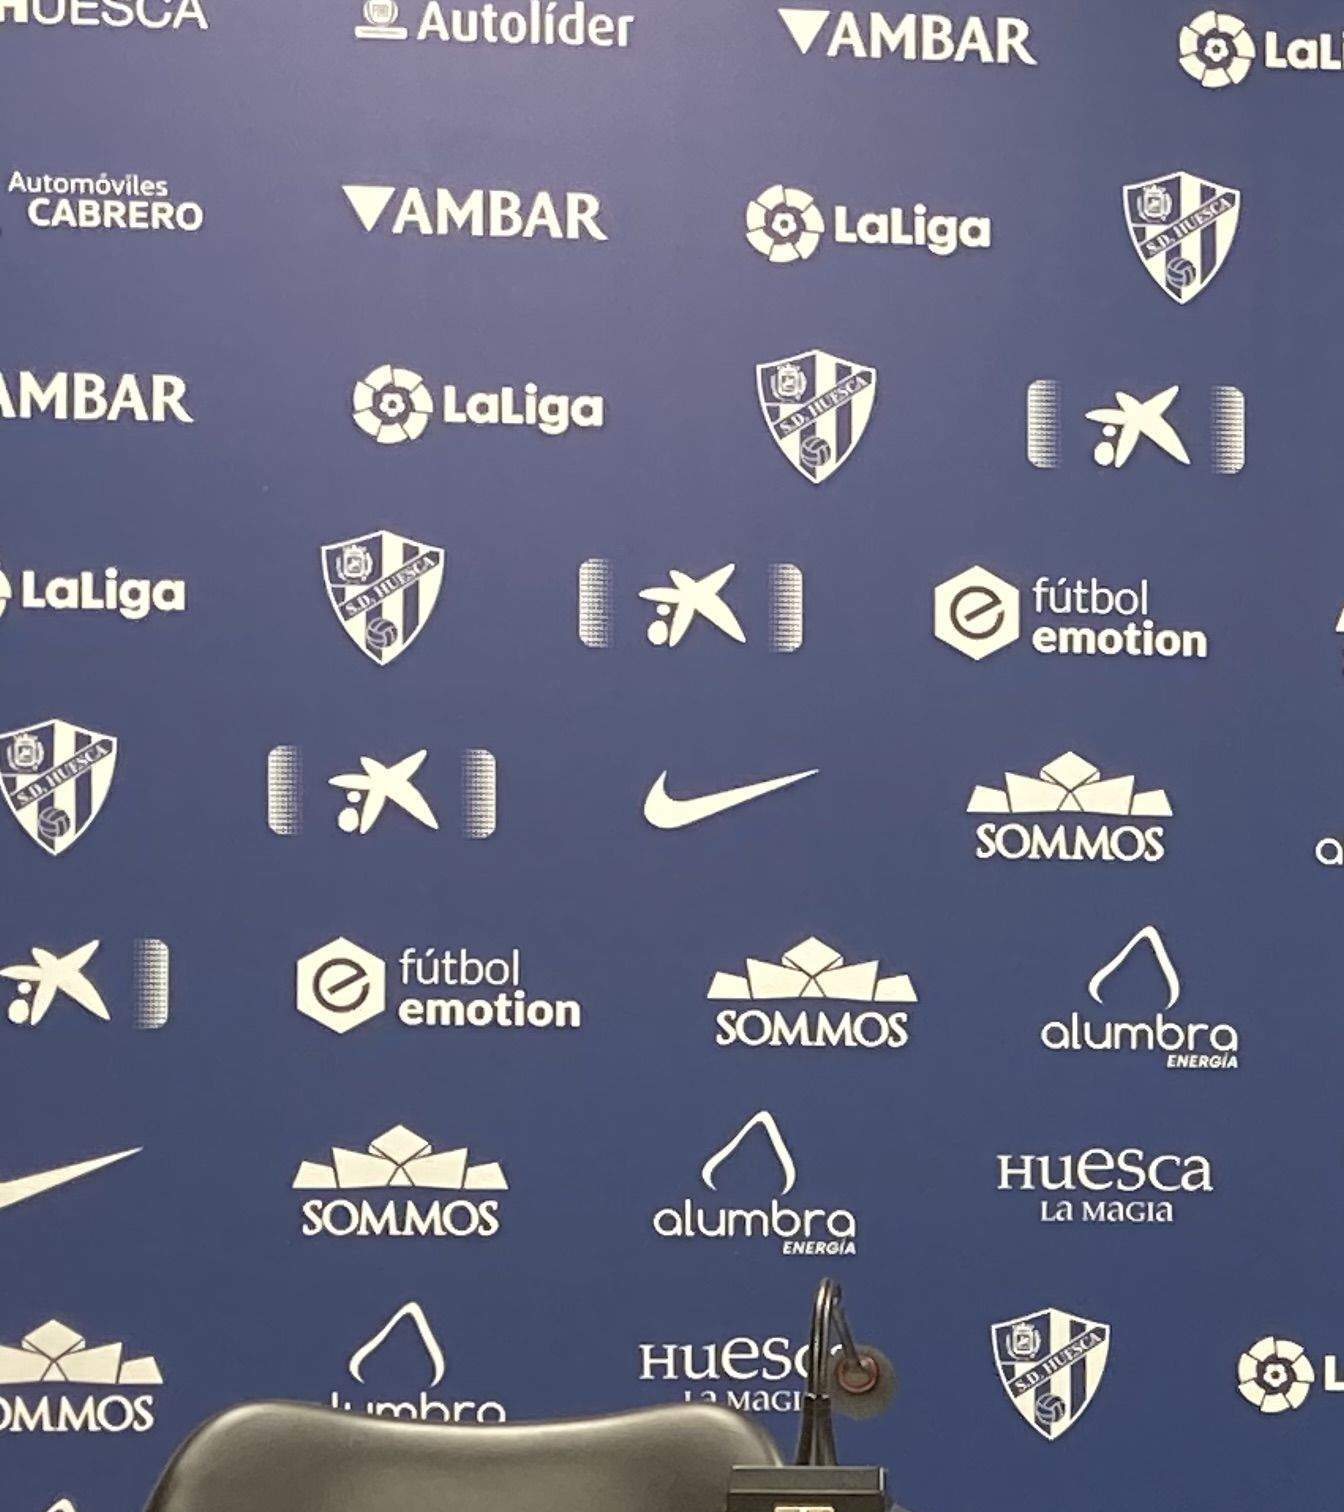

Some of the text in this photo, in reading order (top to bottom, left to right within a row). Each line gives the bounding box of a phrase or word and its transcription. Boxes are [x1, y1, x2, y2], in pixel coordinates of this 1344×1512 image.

[0, 0, 208, 29] HUESCA
[417, 0, 634, 46] Autolíder
[827, 11, 1037, 64] AMBAR
[9, 171, 167, 196] Automóviles
[28, 198, 203, 230] CABRERO
[392, 188, 608, 240] AMBAR
[835, 204, 990, 255] LaLiga
[444, 382, 603, 434] LaLiga
[23, 567, 185, 619] LaLiga
[1033, 577, 1147, 615] fútbol
[1033, 620, 1206, 657] emotion
[976, 823, 1164, 861] SOMMOS
[399, 948, 518, 985] fútbol
[399, 990, 580, 1027] emotion
[717, 1010, 908, 1047] SOMMOS
[1041, 1012, 1237, 1051] alumbra
[303, 1200, 499, 1235] SOMMOS
[654, 1199, 855, 1237] alumbra
[638, 1336, 843, 1381] Hues
[0, 1395, 153, 1431] MMOS
